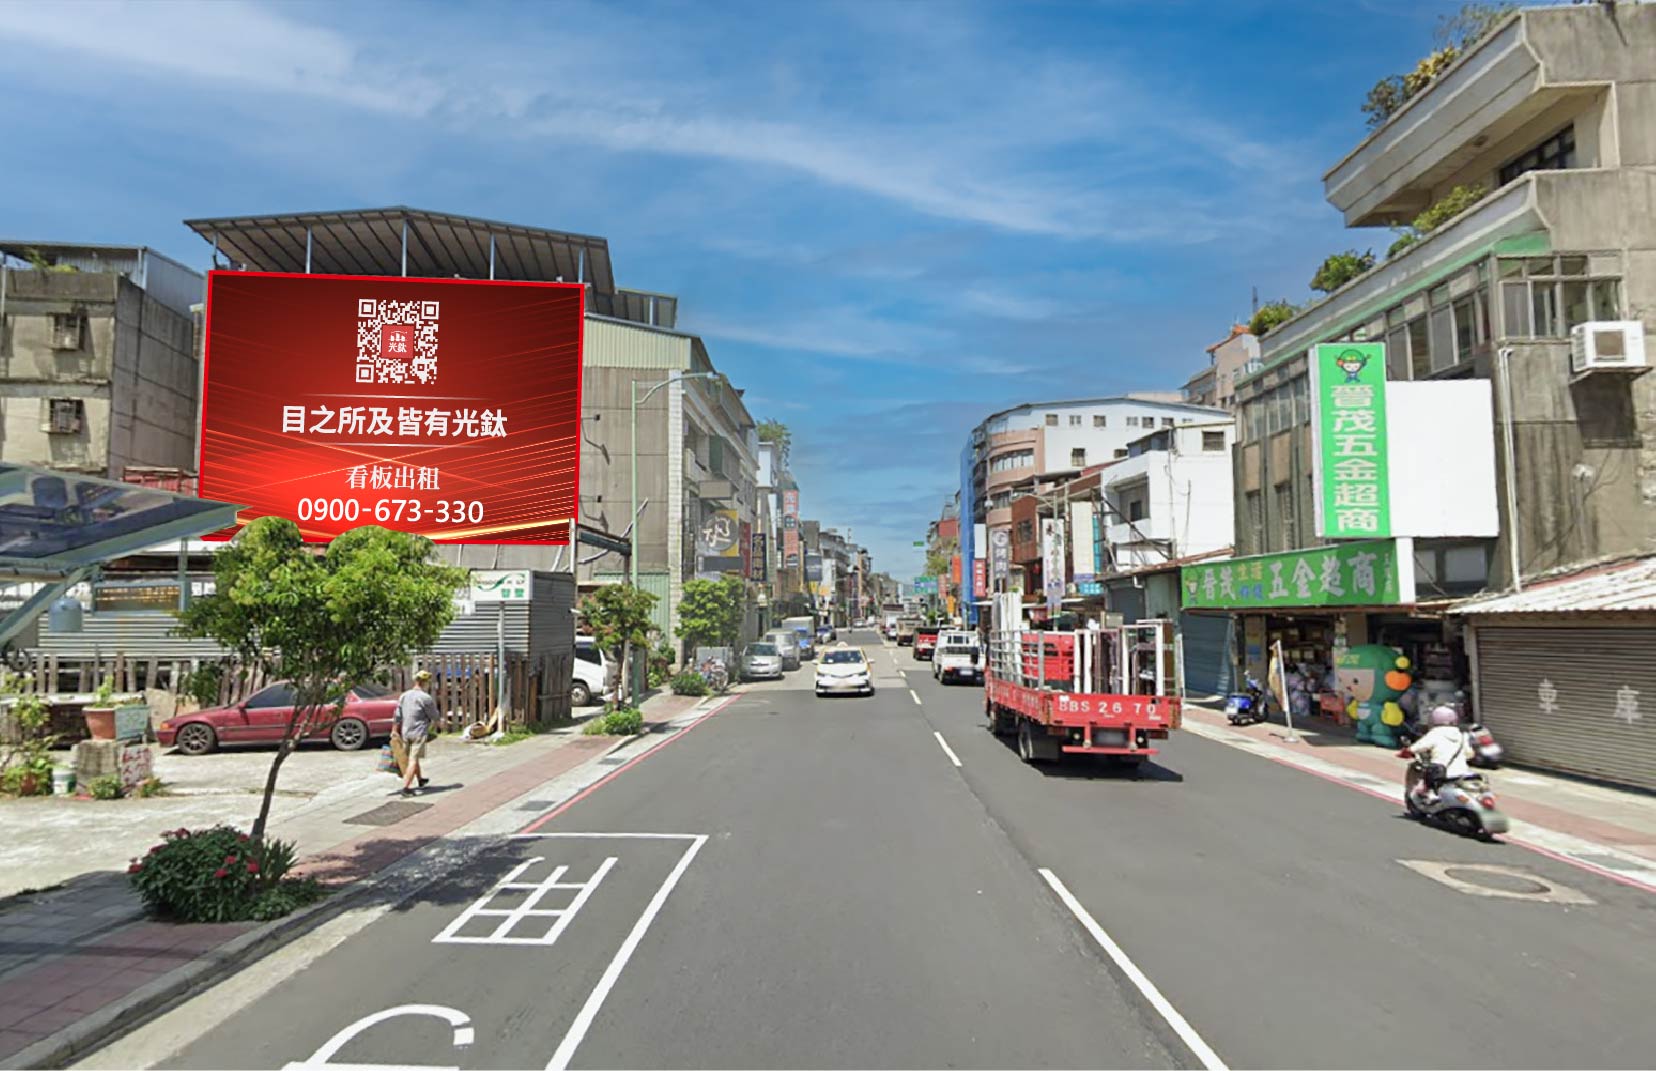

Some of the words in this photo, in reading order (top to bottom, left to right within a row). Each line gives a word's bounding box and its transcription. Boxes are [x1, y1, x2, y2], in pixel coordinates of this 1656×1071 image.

[388, 342, 407, 353] 光鈦
[282, 405, 508, 437] 目之所及皆有光鈦
[345, 465, 440, 490] 看板出租
[297, 498, 484, 523] 0900-673-330
